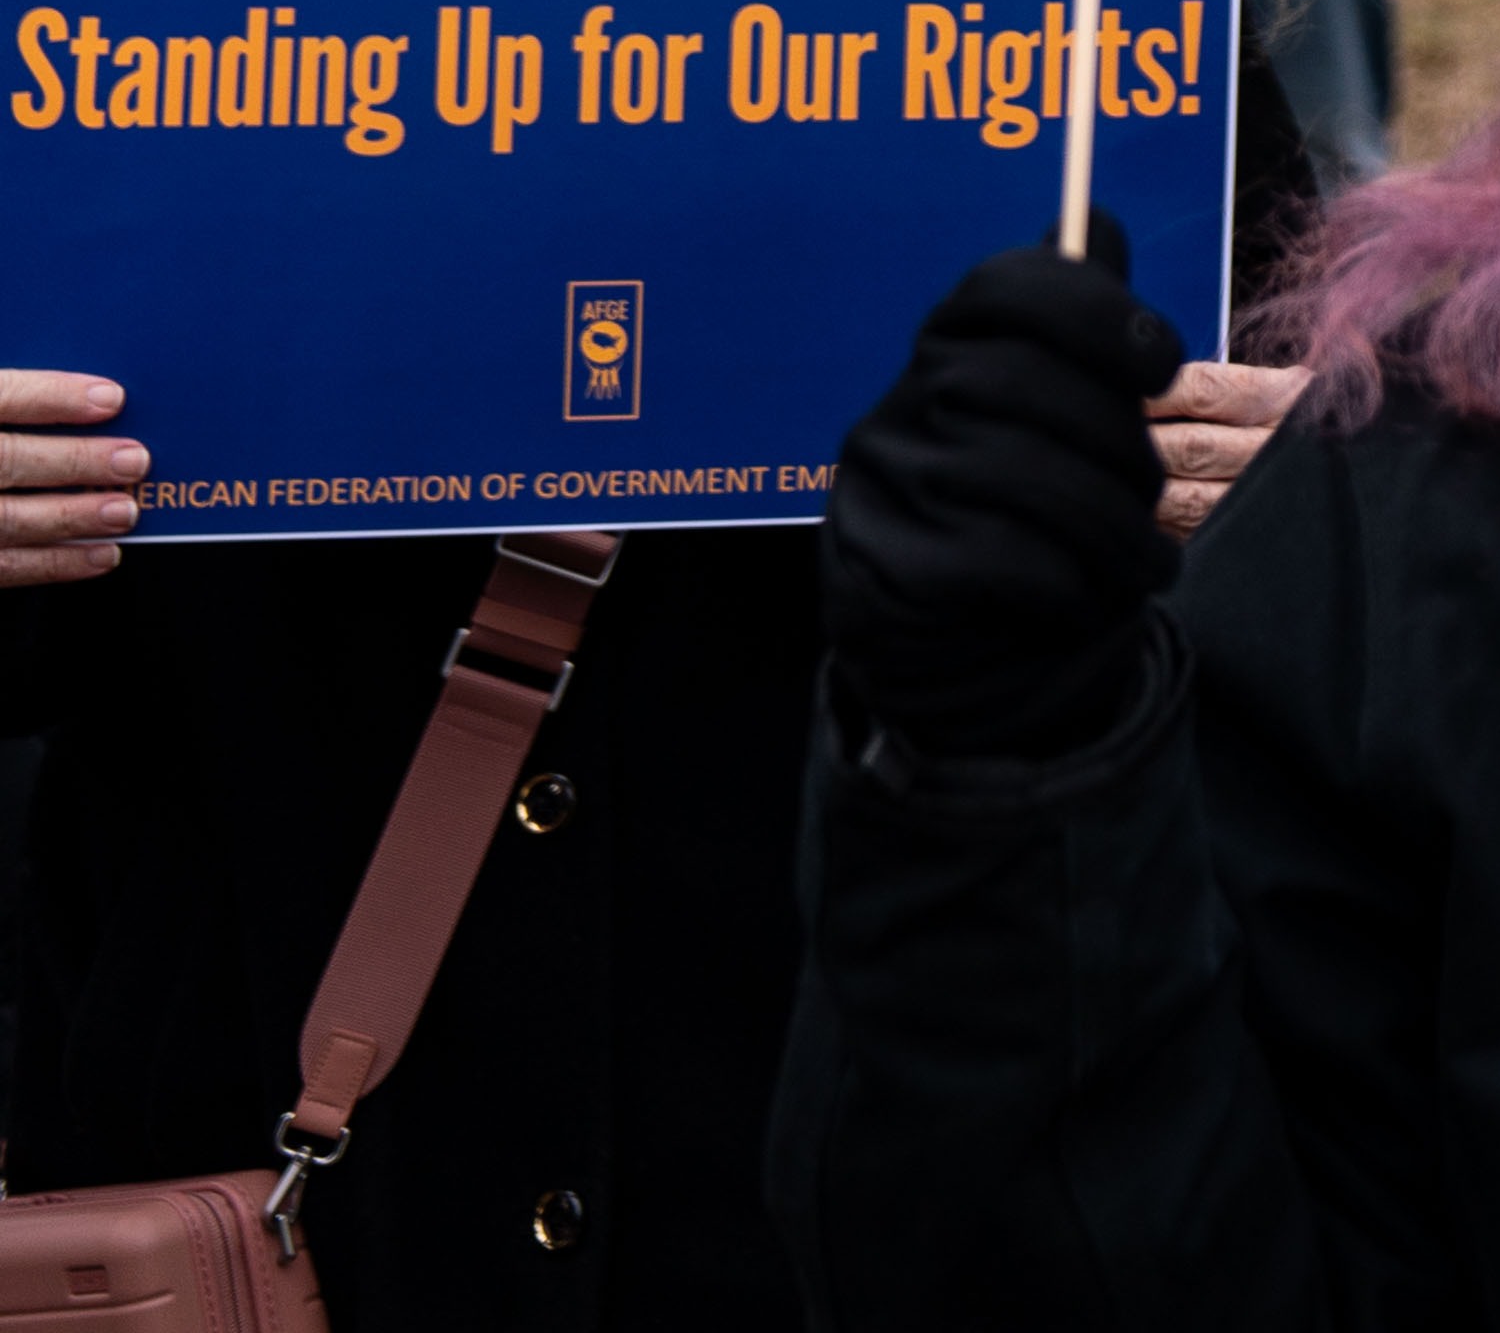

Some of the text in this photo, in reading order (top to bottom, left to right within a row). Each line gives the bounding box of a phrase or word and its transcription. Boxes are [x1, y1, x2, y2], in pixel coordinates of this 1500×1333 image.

[12, 0, 1202, 156] Standing Up for Our Rights!
[581, 298, 630, 321] AFGE
[137, 479, 258, 510] ERICAN
[267, 474, 471, 508] FEDERATION
[480, 471, 526, 502] OF
[533, 465, 770, 499] GOVERNMENT
